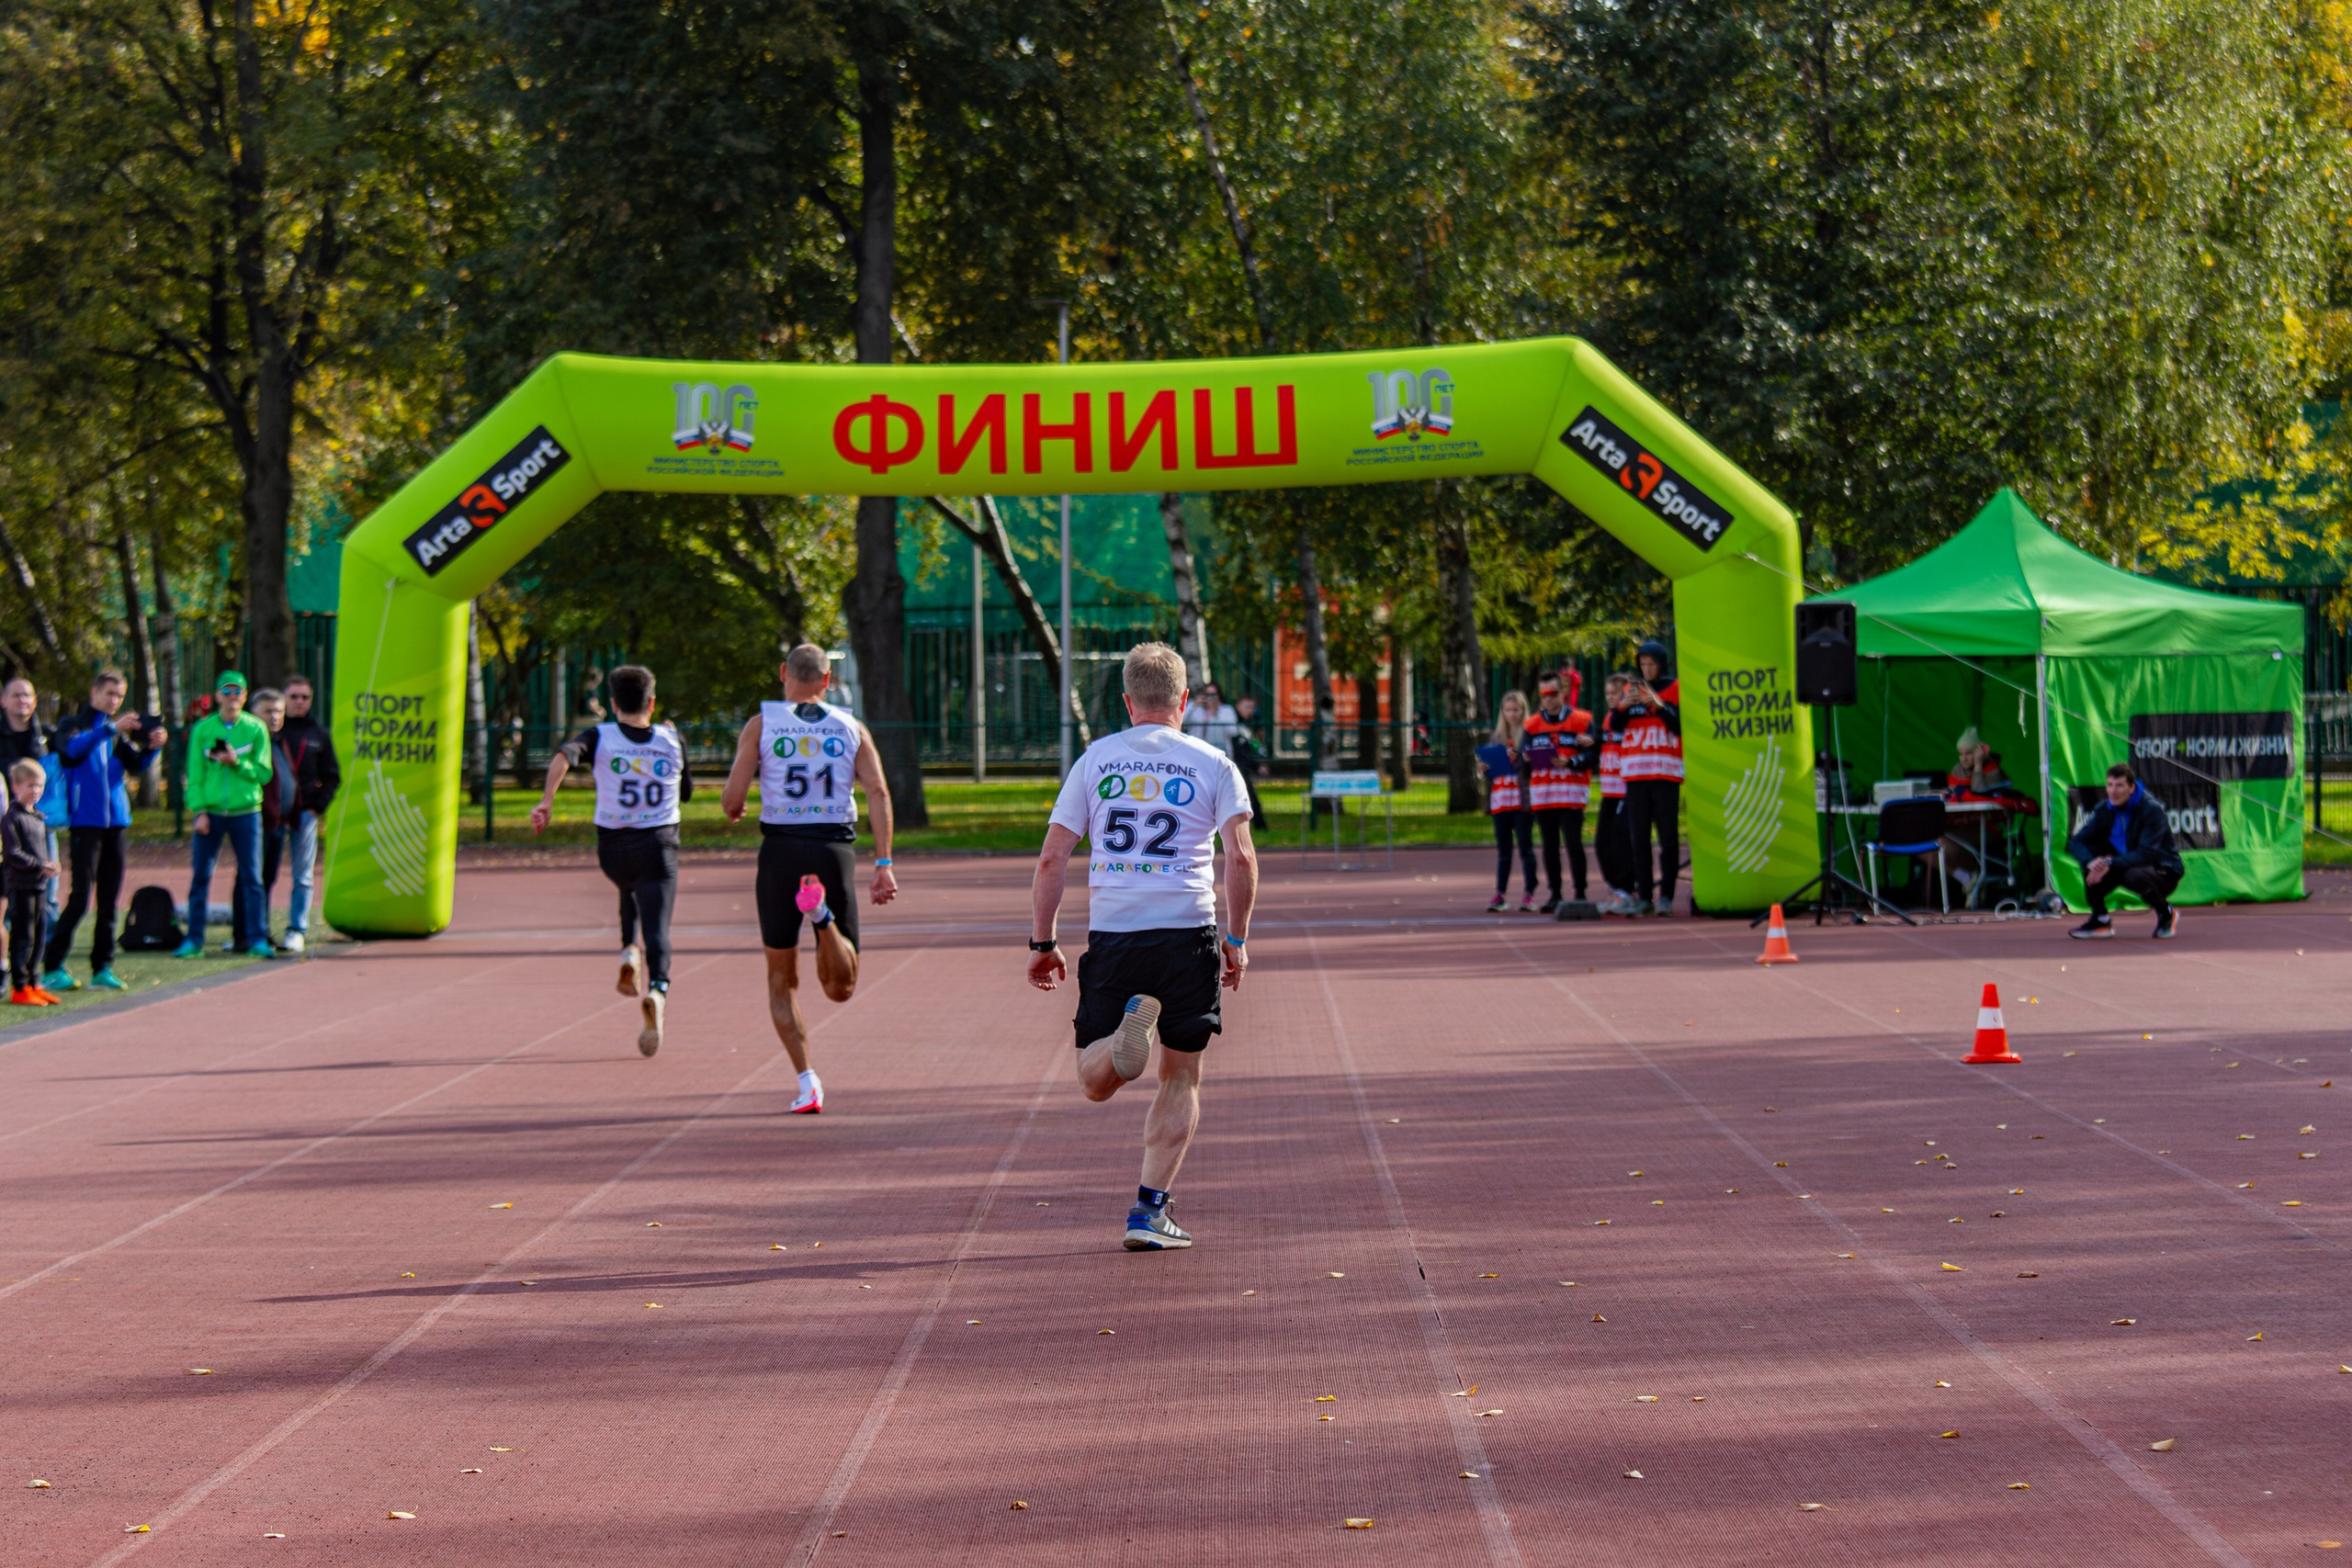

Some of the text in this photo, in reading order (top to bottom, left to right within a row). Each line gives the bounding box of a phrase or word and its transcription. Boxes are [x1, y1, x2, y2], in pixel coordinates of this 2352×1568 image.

[832, 385, 1298, 475] ФИНИШ
[1346, 450, 1484, 466] РОССИЙСКОЙ ФЕДЕРАЦИИ
[1352, 441, 1479, 456] МИНИСТЕРСТВО СПОРТА
[1570, 419, 1722, 542] Arta Sport
[416, 439, 561, 567] Arta Sport
[1708, 667, 1777, 693] СПОРТ
[355, 693, 425, 716] СПОРТ
[1710, 690, 1792, 716] НОРМА
[355, 716, 437, 739] НОРМА
[772, 728, 845, 736] VMARAFONE
[1713, 714, 1794, 739] ЖИЗНИ
[355, 739, 437, 763] ЖИЗНИ
[2134, 736, 2289, 759] СПОРТ НОРМА ЖИЗНИ
[784, 763, 834, 801] 51
[1099, 761, 1197, 778] VMARAFONE
[618, 779, 663, 807] 50
[2165, 805, 2218, 834] port
[1103, 807, 1181, 858] 52
